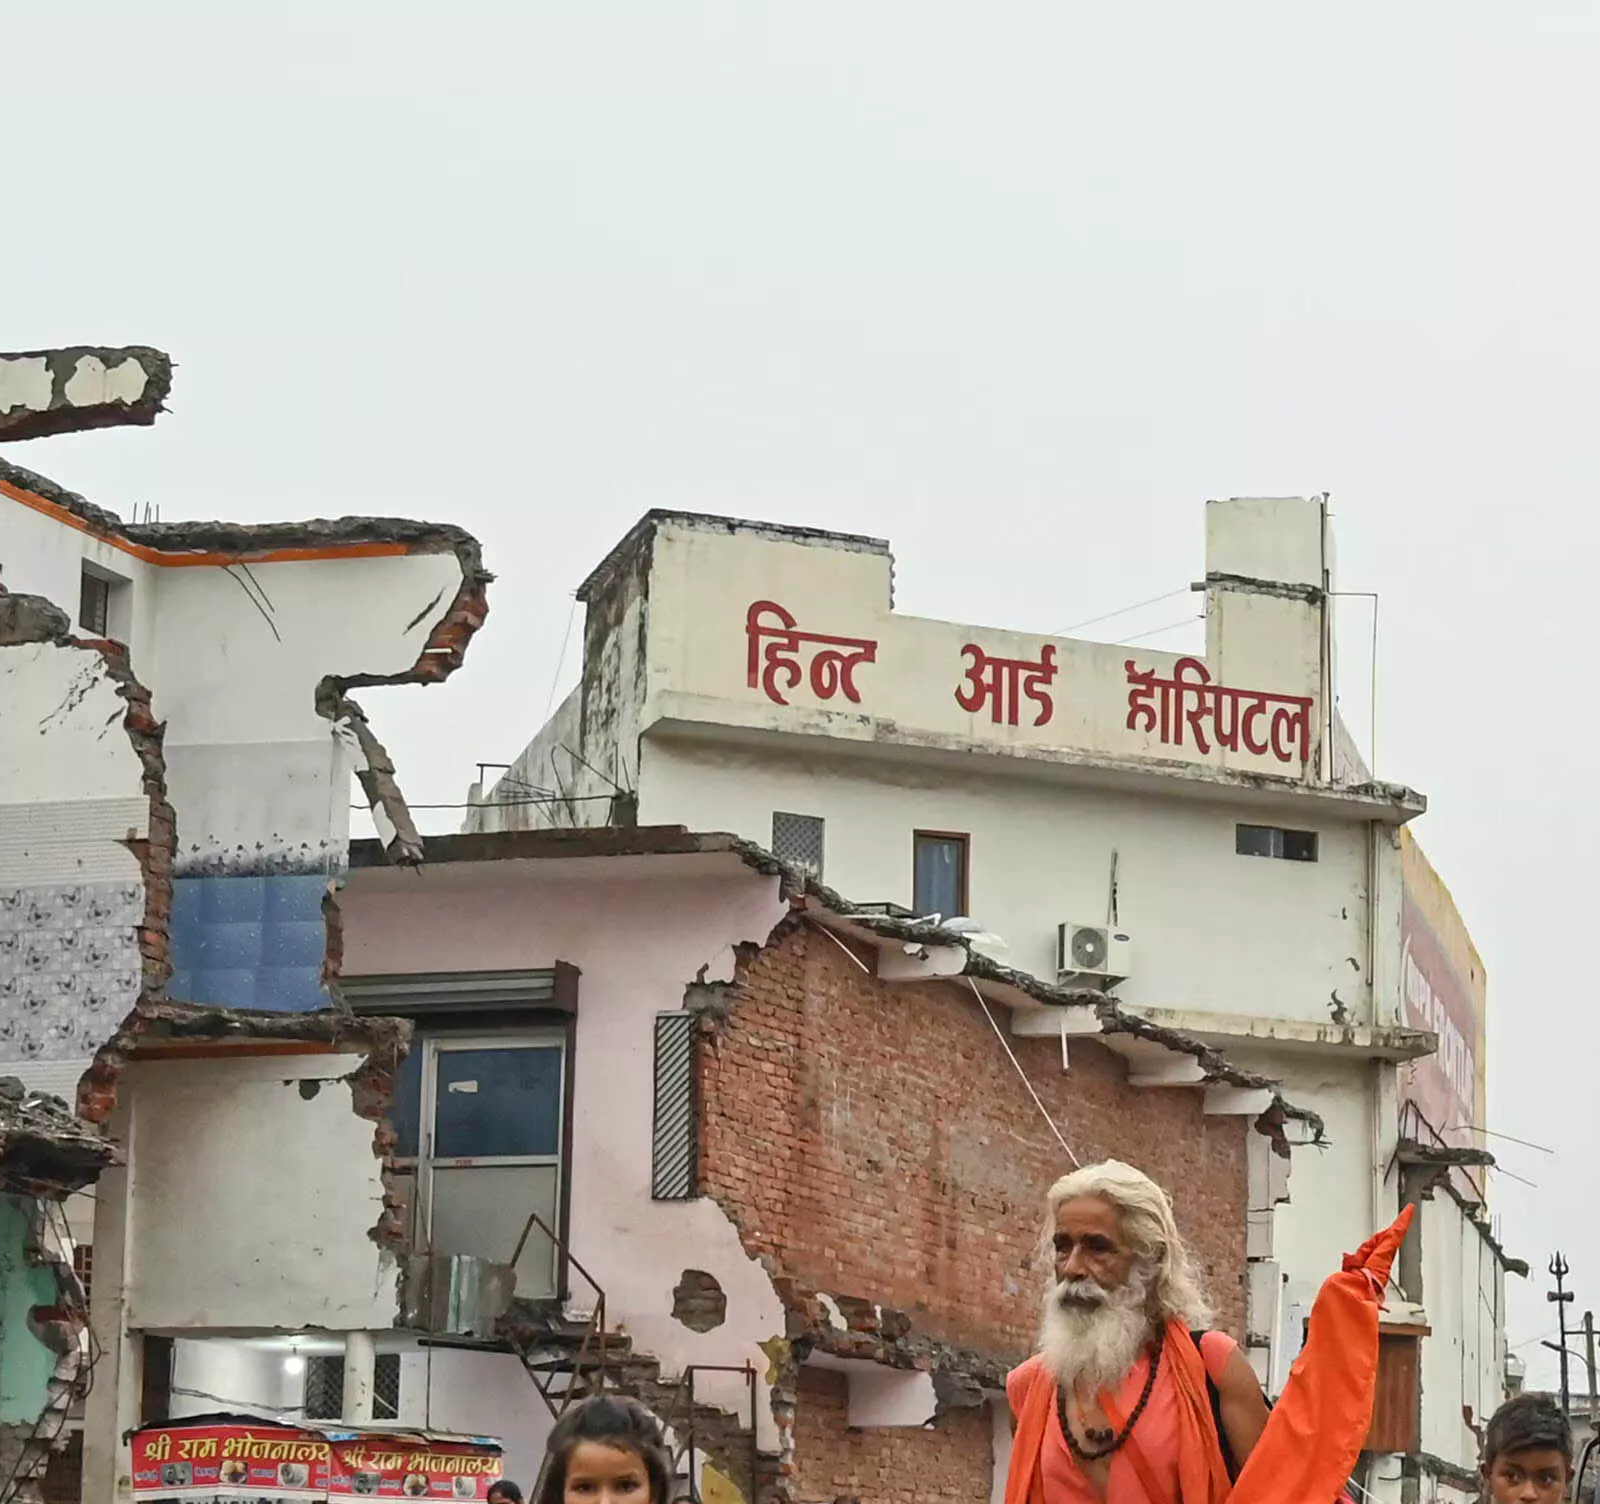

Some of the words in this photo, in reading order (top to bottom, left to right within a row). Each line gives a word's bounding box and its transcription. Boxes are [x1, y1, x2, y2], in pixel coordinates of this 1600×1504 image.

[1124, 657, 1314, 764] हॉस्पिटल
[144, 1434, 171, 1461] श्री
[177, 1438, 218, 1458] राम
[343, 1445, 366, 1469] श्री
[367, 1451, 402, 1470] राम
[407, 1449, 500, 1474] भोजनालय
